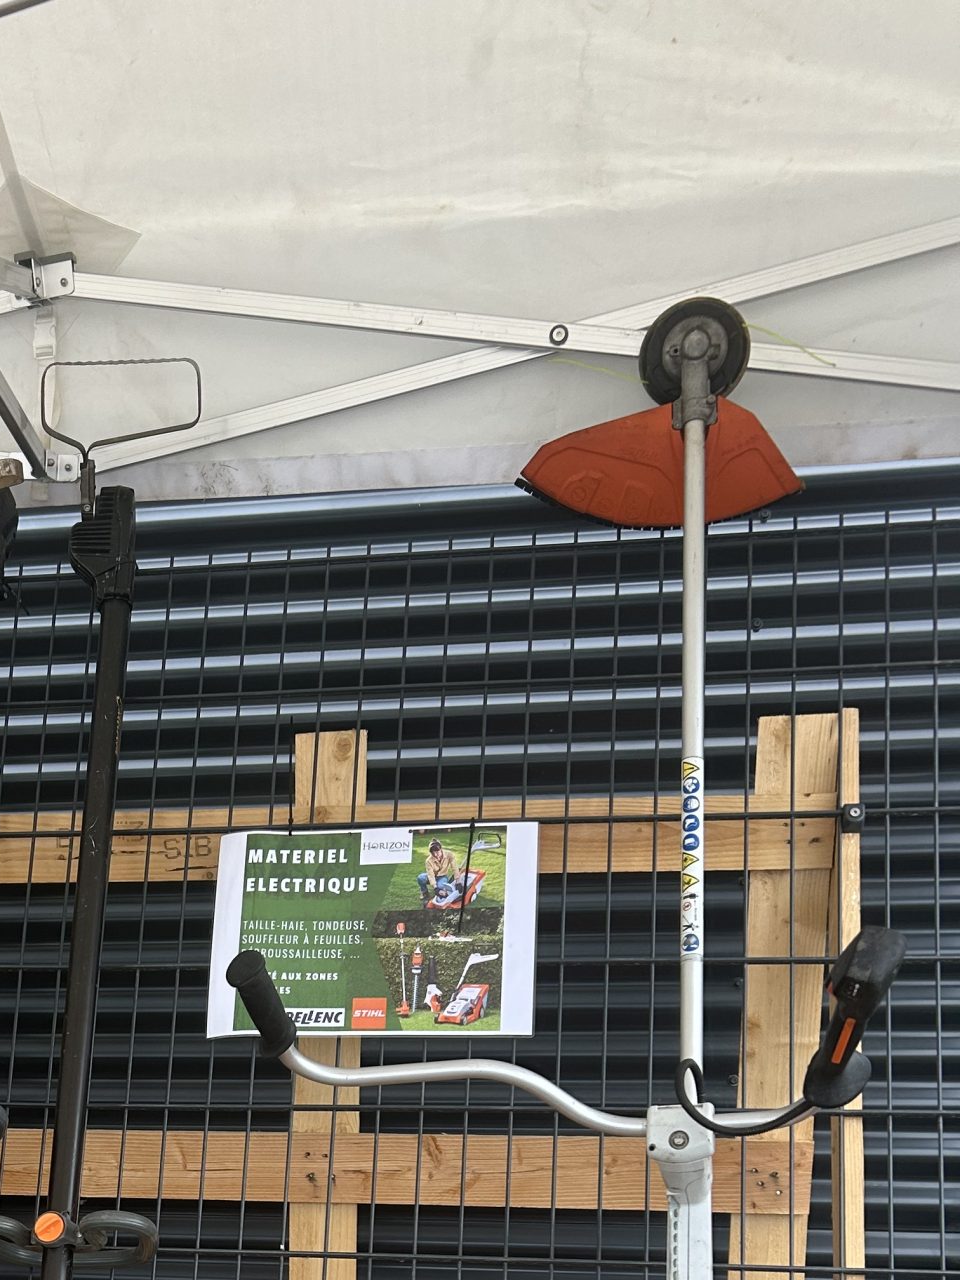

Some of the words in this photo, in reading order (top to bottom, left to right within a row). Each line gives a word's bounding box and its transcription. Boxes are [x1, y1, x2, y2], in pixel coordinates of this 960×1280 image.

[363, 841, 410, 850] HORIZON
[248, 848, 348, 864] MATERIEL
[246, 876, 369, 894] ELECTRIQUE
[243, 920, 308, 931] TAILLE-HAIE,
[313, 920, 368, 931] TONDEUSE,
[241, 934, 299, 945] SOUFFLEUR
[313, 934, 364, 946] FEUILLES,
[281, 972, 302, 981] AUX
[306, 972, 338, 981] ZONES
[352, 1009, 385, 1017] STIHL
